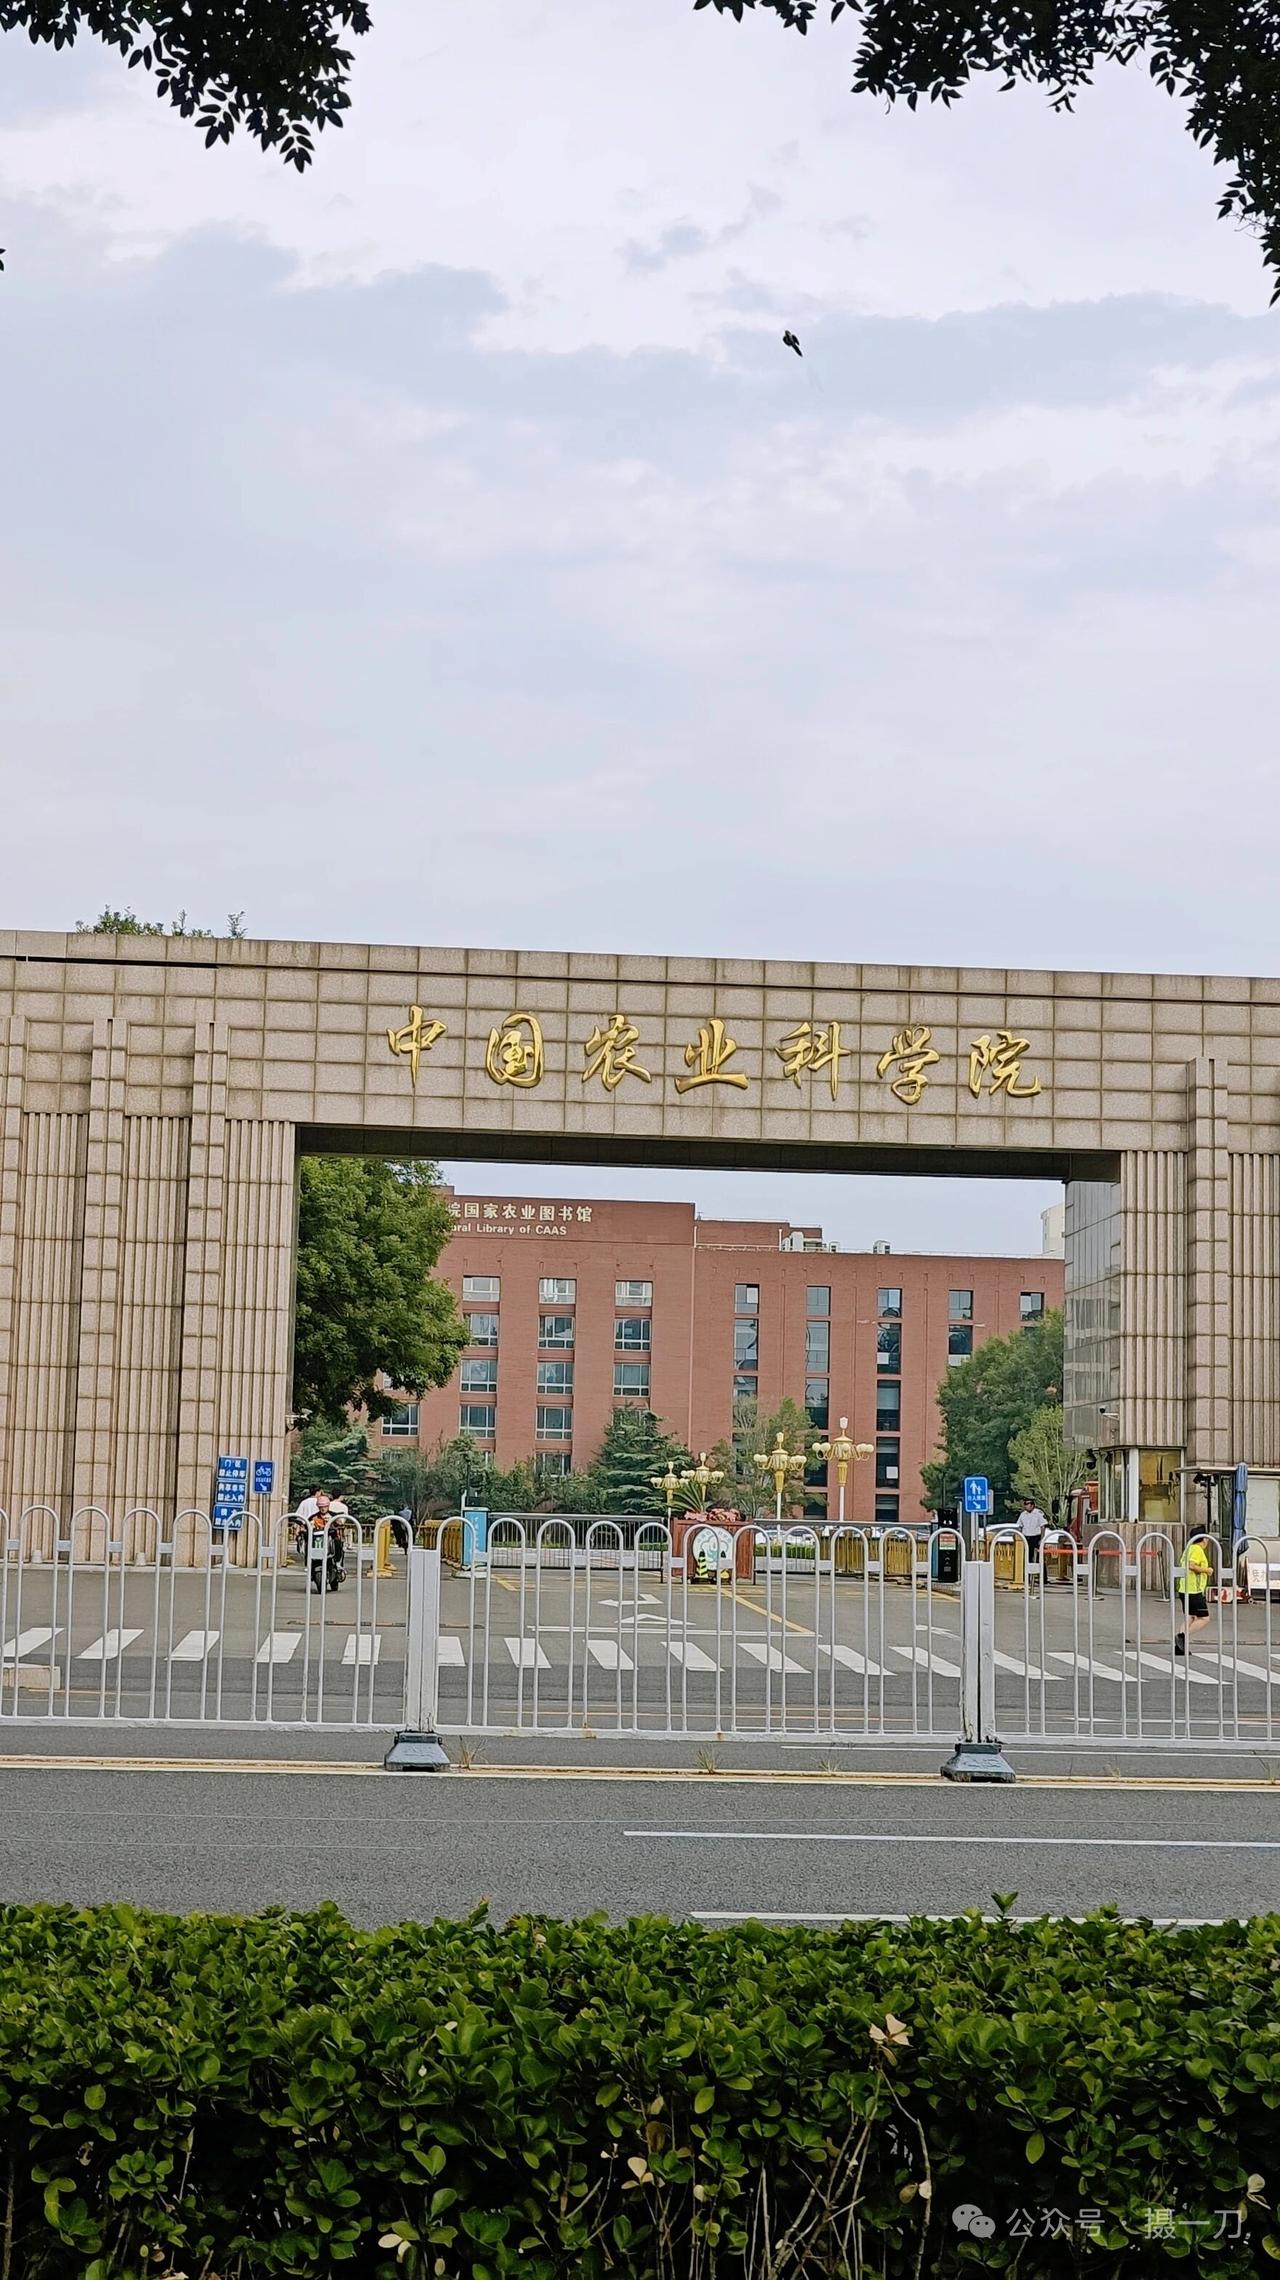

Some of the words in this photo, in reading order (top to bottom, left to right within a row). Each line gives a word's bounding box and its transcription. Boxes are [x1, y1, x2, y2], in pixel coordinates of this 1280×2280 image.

[387, 1005, 1043, 1105] 中国农业科学院
[476, 1223, 515, 1235] Library
[519, 1225, 531, 1234] of
[535, 1225, 567, 1236] CAAS
[217, 1493, 244, 1502] 禁止入内
